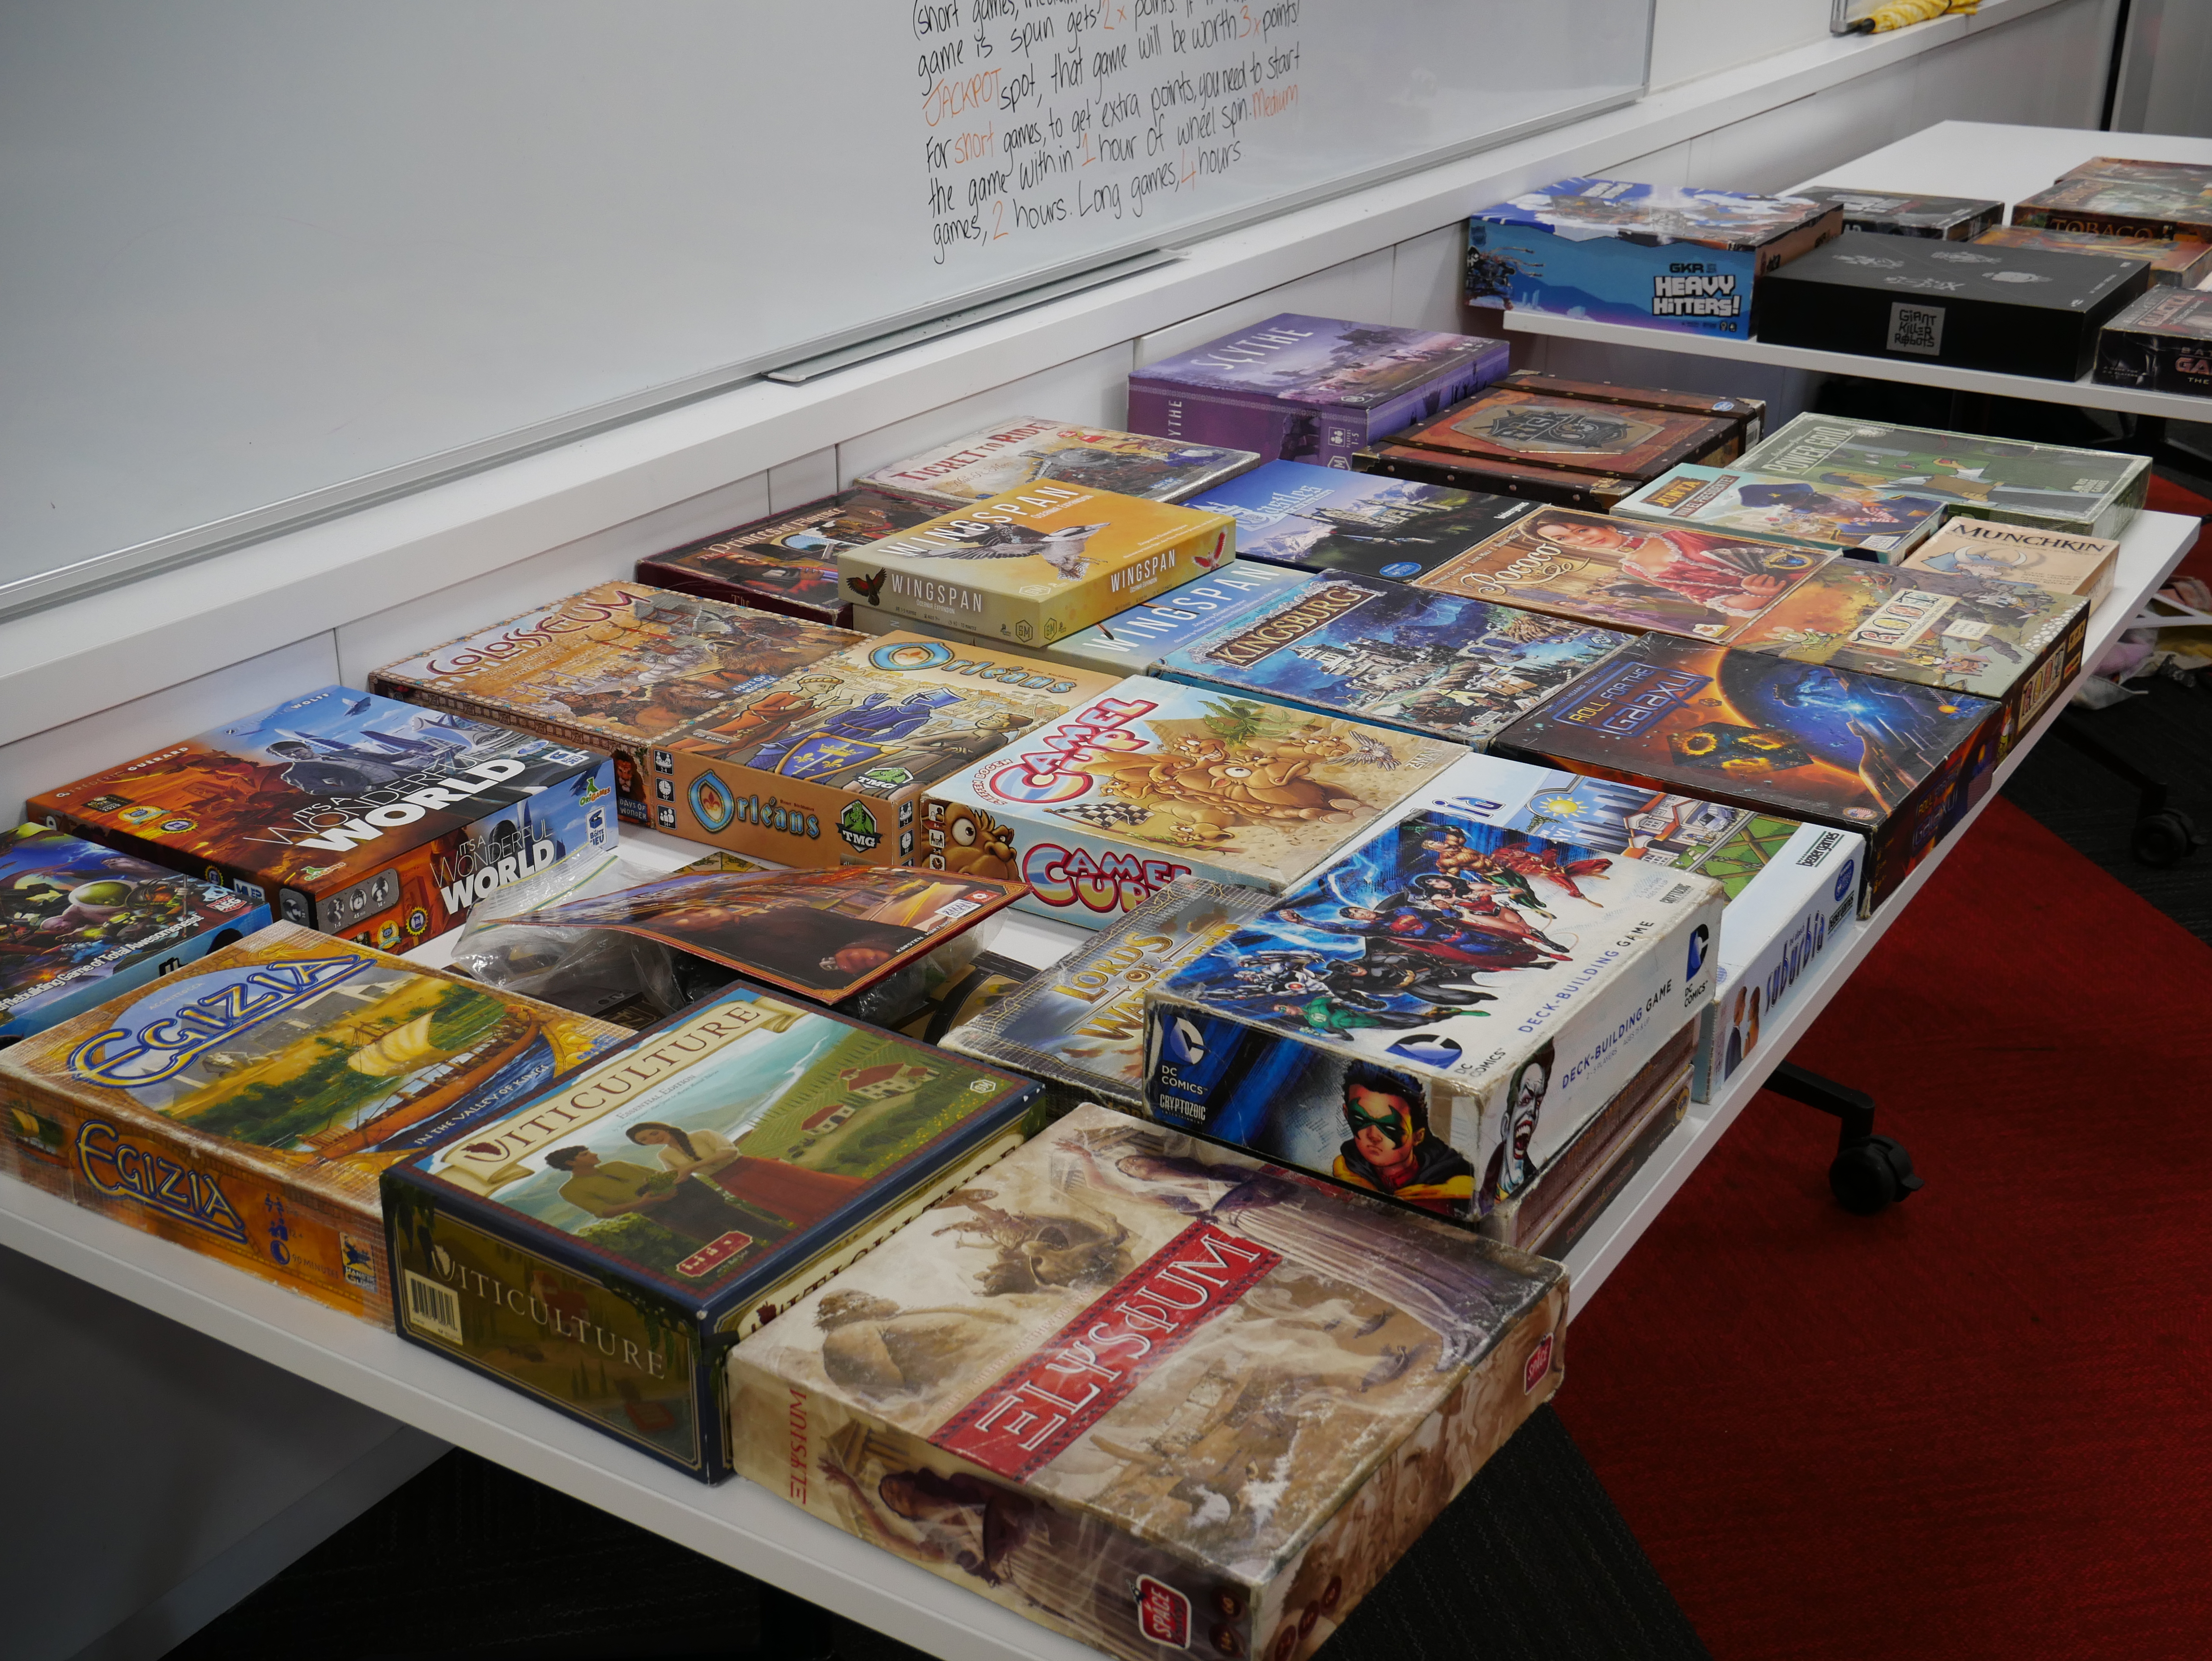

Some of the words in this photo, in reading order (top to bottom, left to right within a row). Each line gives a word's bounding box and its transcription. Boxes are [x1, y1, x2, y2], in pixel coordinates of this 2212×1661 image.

[919, 40, 963, 96] game
[977, 29, 993, 58] is
[1011, 16, 1054, 58] spun
[1067, 4, 1096, 53] gets
[922, 68, 1001, 126] JACKPOT
[1000, 63, 1042, 113] spot,
[1051, 47, 1082, 94] that
[1093, 43, 1128, 105] game
[1139, 24, 1162, 59] will
[1172, 20, 1186, 53] be
[1192, 9, 1237, 49] worth
[926, 136, 951, 173] For
[955, 120, 994, 163] short
[1003, 122, 1046, 177] games,
[1049, 107, 1063, 139] to
[1072, 99, 1091, 149] get
[1102, 92, 1141, 128] extra
[1199, 71, 1220, 111] you
[1223, 60, 1247, 93] need
[1250, 51, 1262, 85] to
[1266, 40, 1300, 79] start
[928, 177, 955, 218] the
[969, 171, 1008, 219] game
[1020, 145, 1073, 190] within
[1082, 132, 1096, 167] 1
[1098, 134, 1137, 162] hour
[1177, 106, 1216, 146] wheel
[934, 215, 987, 264] games,
[992, 200, 1009, 240] 2
[1013, 198, 1072, 229] hours.
[1079, 180, 1121, 219] Long
[1131, 161, 1179, 218] games,
[1181, 148, 1196, 192] 4
[1654, 275, 1736, 298] HEAVY
[1669, 263, 1704, 273] GKR
[1190, 327, 1314, 370] SCYTHE
[975, 442, 1004, 453] TO
[987, 422, 1058, 443] RIDE
[1761, 445, 1830, 475] POWER
[1804, 426, 1852, 447] GRID
[888, 449, 988, 481] TICKET
[792, 507, 846, 527] Florence
[1657, 481, 1701, 508] JUNTA
[877, 486, 1080, 556] WINGSPAN
[1952, 524, 2106, 553] MUNCHKIN
[892, 574, 981, 612] WINGSPAN
[1111, 549, 1175, 593] WINGSPAN
[1460, 543, 1562, 596] Rococo
[1082, 567, 1280, 652] WINGSPAN
[1212, 588, 1364, 664] KINGSBURG
[1852, 591, 1942, 645] ROOT
[733, 679, 756, 692] DAYS
[753, 674, 766, 682] OF
[869, 641, 1077, 693] Orléans
[1568, 701, 1611, 722] ROLL
[1600, 682, 1635, 700] FOR
[1621, 668, 1657, 683] THE
[128, 747, 190, 772] GUÉRARD
[692, 731, 706, 739] dlp
[706, 735, 731, 744] games
[990, 698, 1159, 804] CAMEL
[858, 776, 898, 789] TMG
[973, 779, 1008, 805] STEFFEN
[974, 759, 1013, 780] BOGEN
[242, 751, 499, 845] WONDERFUL
[294, 800, 332, 820] IT'S
[329, 795, 354, 807] A
[296, 759, 526, 852] WORLD
[687, 769, 820, 839] Orléans
[430, 819, 554, 888] WONDERFUL
[459, 840, 476, 857] IT'S
[477, 837, 487, 850] A
[843, 829, 876, 848] TMG
[440, 839, 555, 916] WORLD
[215, 897, 241, 911] AEG
[58, 962, 93, 986] Game
[99, 946, 129, 966] Total
[126, 912, 204, 954] Awesomeness!
[895, 936, 924, 953] KARSTEN
[1049, 933, 1173, 1003] LORDS
[1123, 962, 1158, 983] OF
[1518, 949, 1619, 1034] DECK-BUILDING
[1616, 920, 1655, 948] GAME
[1685, 983, 1693, 998] DC
[67, 954, 376, 1090] EGIZIA
[1562, 1008, 1643, 1090] DECK-BUILDING
[1645, 978, 1672, 1012] GAME
[464, 1004, 761, 1165] VITICULTURE
[1162, 1065, 1178, 1078] DC
[1454, 1064, 1474, 1076] DC
[414, 1135, 428, 1146] IN
[433, 1120, 456, 1135] THE
[451, 1095, 499, 1123] VALLEY
[498, 1084, 514, 1096] OF
[514, 1063, 550, 1087] KINGS
[617, 1094, 663, 1120] ESSENTIAL
[661, 1074, 698, 1095] EDITION
[1159, 1093, 1206, 1121] CRYPTOZOIC
[76, 1120, 247, 1246] EGIZIA
[292, 1254, 303, 1264] 90
[431, 1245, 665, 1379] VITICULTURE
[976, 1232, 1262, 1451] ELYSIUM
[789, 1387, 808, 1504] ELYSIUM
[1151, 1587, 1172, 1637] SPACE
